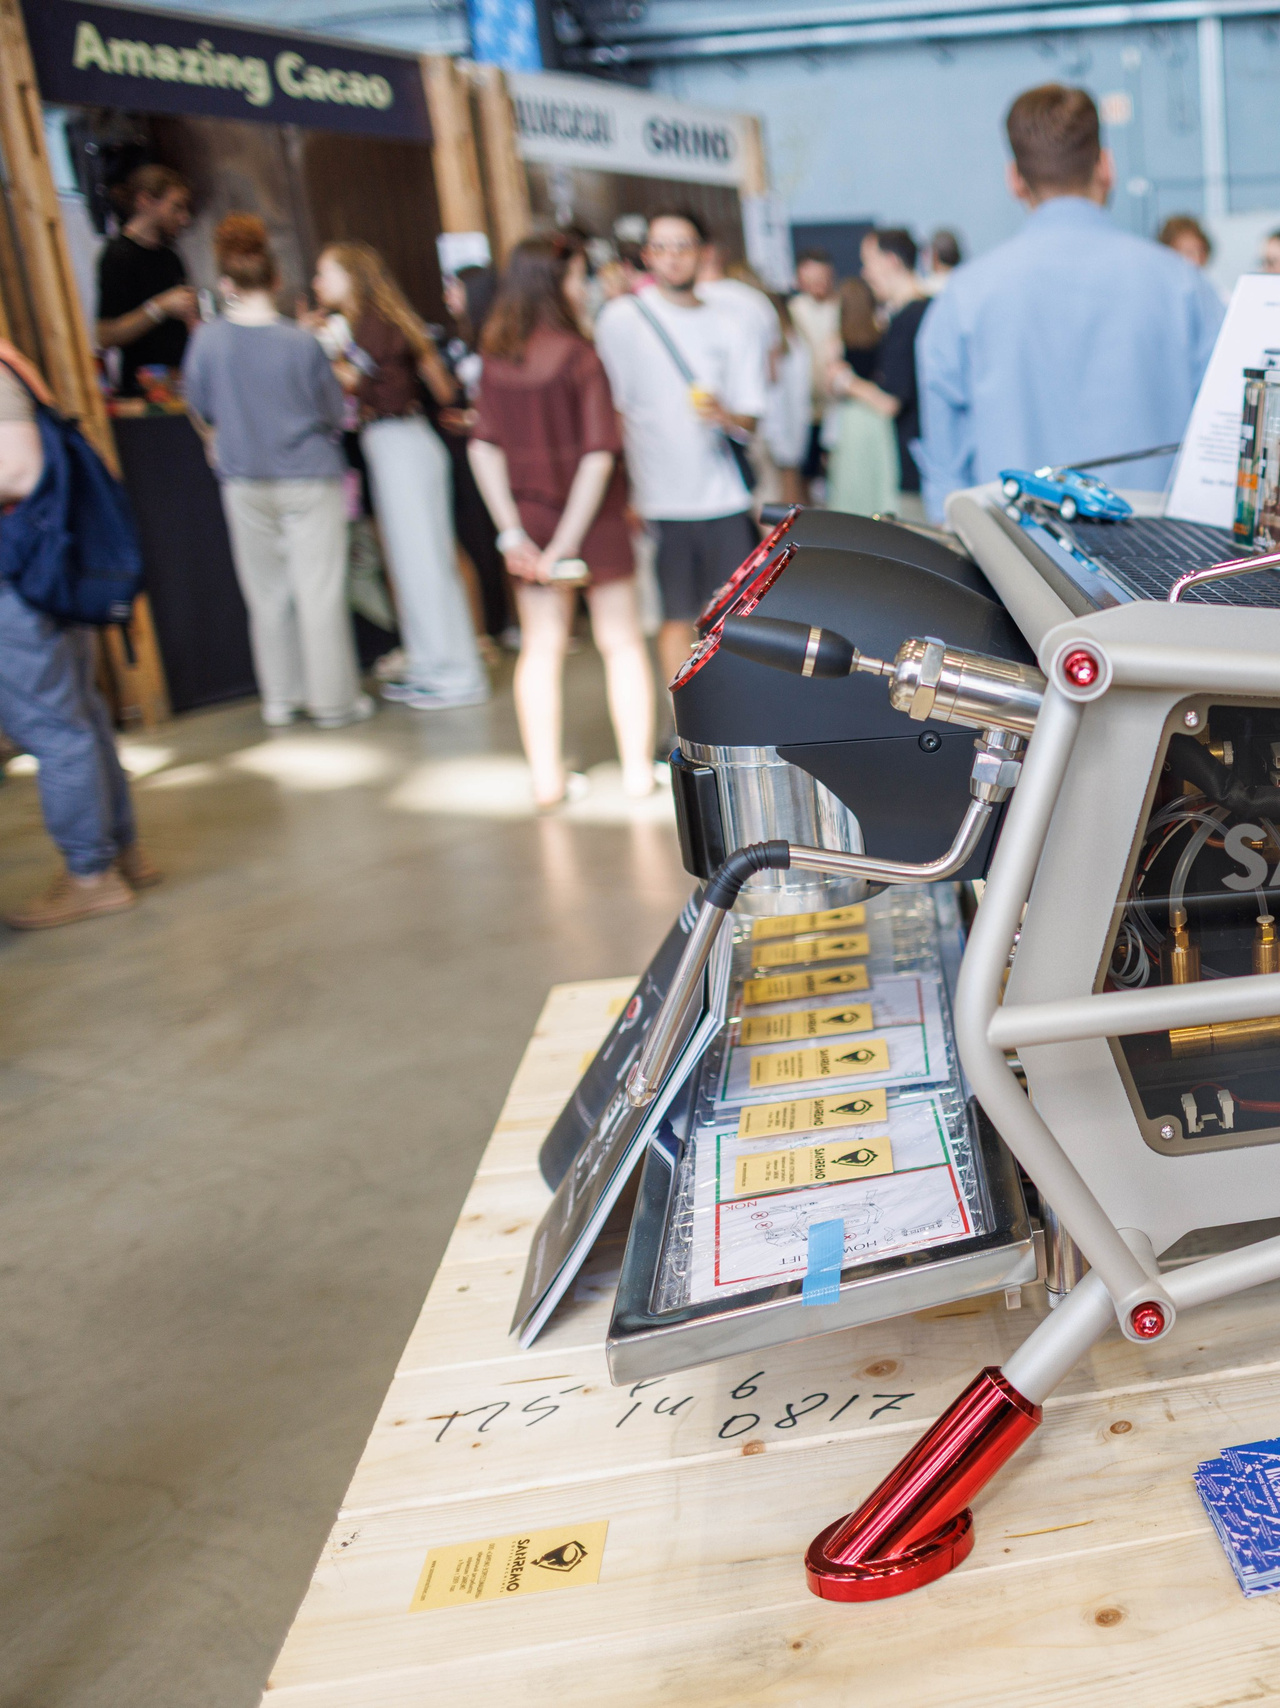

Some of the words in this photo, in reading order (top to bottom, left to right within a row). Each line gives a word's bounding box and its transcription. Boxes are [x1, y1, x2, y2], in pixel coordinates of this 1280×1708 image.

[72, 21, 273, 107] Amazing
[275, 51, 394, 110] Cacao
[814, 1099, 824, 1126] SANREMO
[815, 1148, 826, 1180] SANREMO
[725, 1200, 757, 1211] NOK
[506, 1538, 530, 1592] SANREMO
